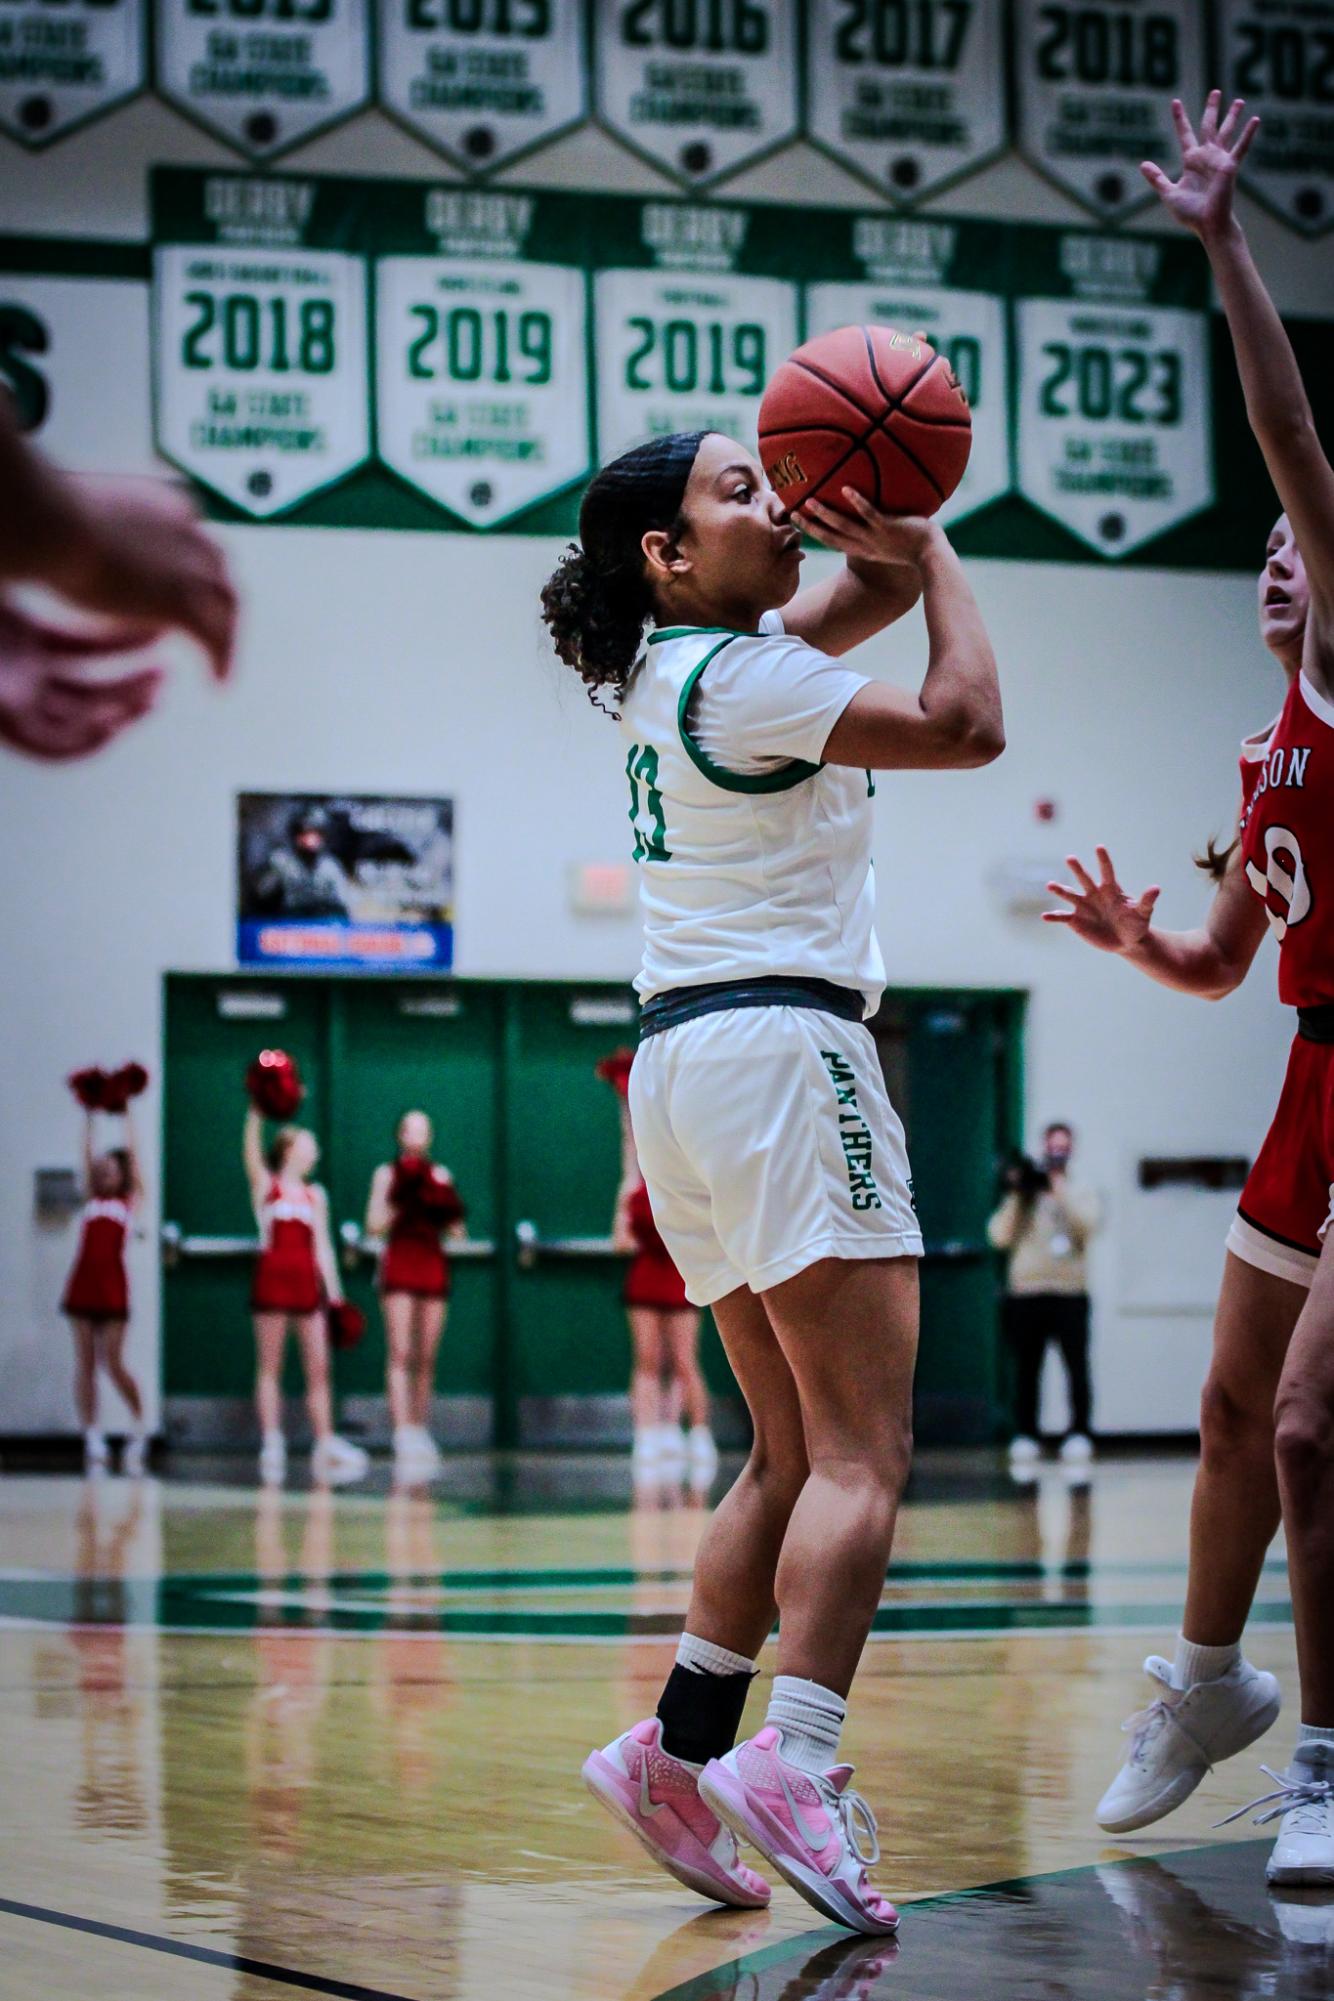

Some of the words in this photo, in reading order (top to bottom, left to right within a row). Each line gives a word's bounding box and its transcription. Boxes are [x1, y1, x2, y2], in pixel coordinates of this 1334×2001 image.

[834, 0, 973, 71] 2017
[1038, 5, 1178, 90] 2018
[183, 290, 336, 375] 2018
[408, 304, 552, 384] 2019
[624, 317, 768, 396] 2019
[1039, 341, 1182, 428] 2023
